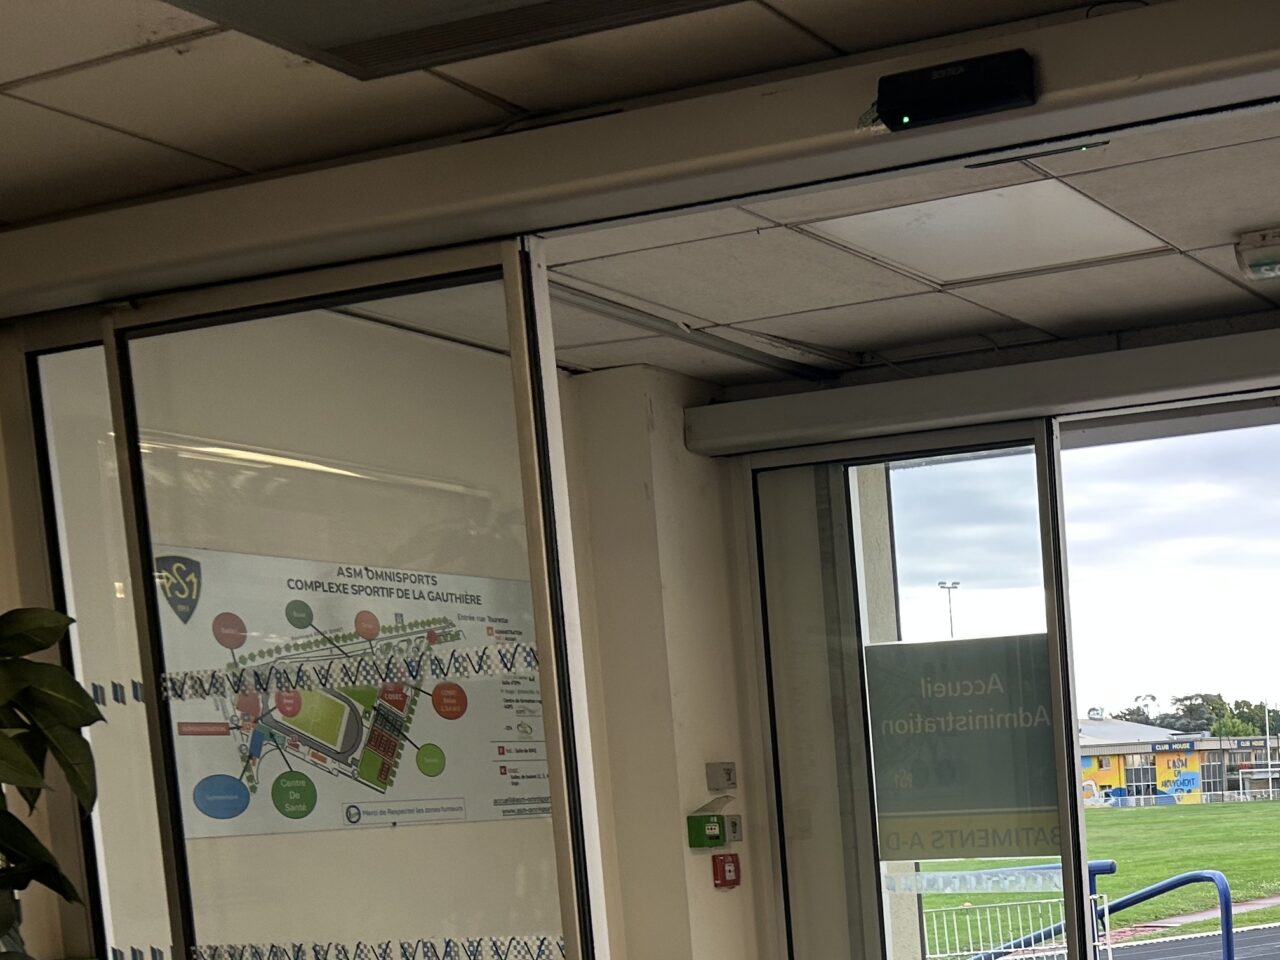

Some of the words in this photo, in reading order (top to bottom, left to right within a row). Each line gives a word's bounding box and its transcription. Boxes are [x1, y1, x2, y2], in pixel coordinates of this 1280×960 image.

[337, 566, 363, 579] ASM
[366, 568, 438, 586] OMNISPORTS
[287, 578, 349, 595] COMPLEXE
[351, 585, 395, 598] SPORTIF
[397, 588, 410, 600] DE
[412, 589, 425, 601] LA
[427, 590, 483, 605] GAUTHIÈRE
